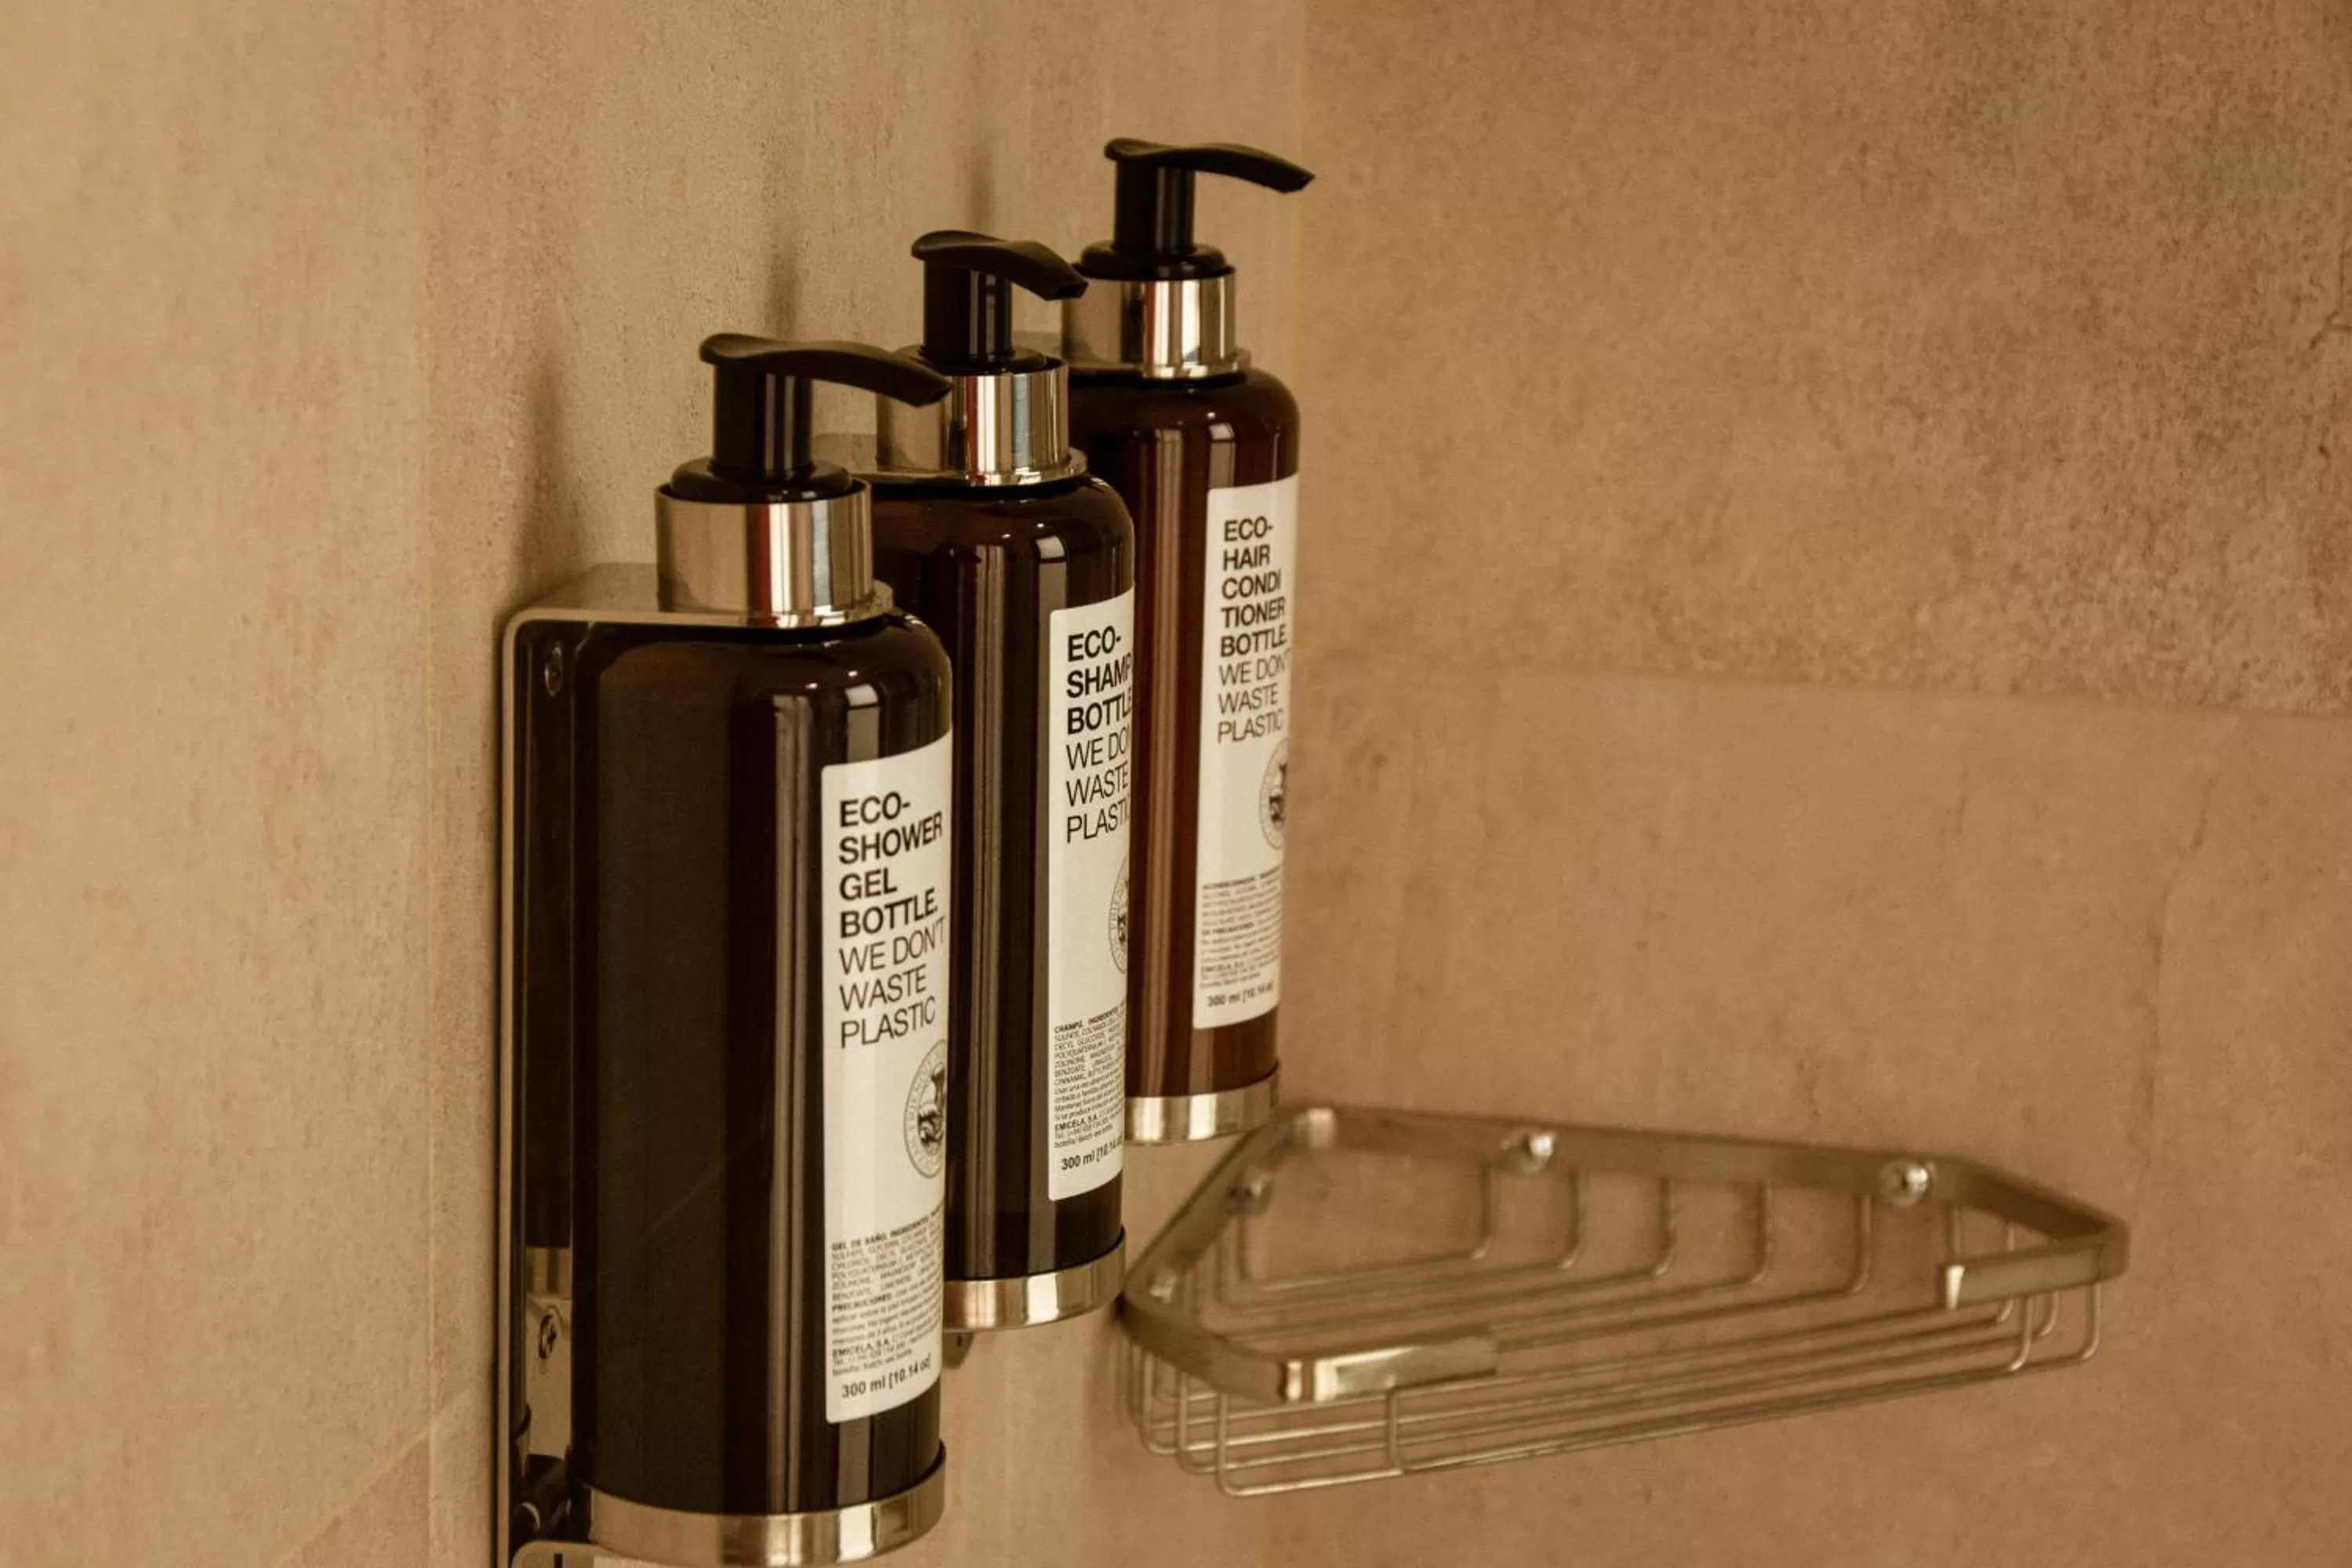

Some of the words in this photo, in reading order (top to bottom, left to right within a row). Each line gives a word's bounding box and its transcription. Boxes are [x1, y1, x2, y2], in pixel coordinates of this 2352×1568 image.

[1224, 516, 1273, 542] ECO-
[1223, 544, 1270, 571] HAIR
[1221, 568, 1281, 600] CONDI
[1221, 596, 1286, 628] TIONER
[1068, 626, 1121, 662] ECO-
[1066, 652, 1131, 699] SHAMP
[1219, 661, 1251, 686] WE
[1218, 682, 1278, 715] WASTE
[1218, 708, 1283, 744] PLASTIC
[1066, 738, 1103, 771] WE
[1066, 761, 1128, 807] WASTE
[840, 792, 911, 827] ECO-
[839, 811, 942, 865] SHOWER
[840, 868, 898, 901] GEL
[839, 941, 885, 975] WE
[894, 915, 946, 967] DON'T
[839, 964, 927, 1011] WASTE
[840, 996, 936, 1049] PLASTIC
[1062, 1155, 1081, 1171] 300
[1083, 1148, 1095, 1166] ml
[842, 1380, 866, 1399] 300
[870, 1375, 885, 1392] ml
